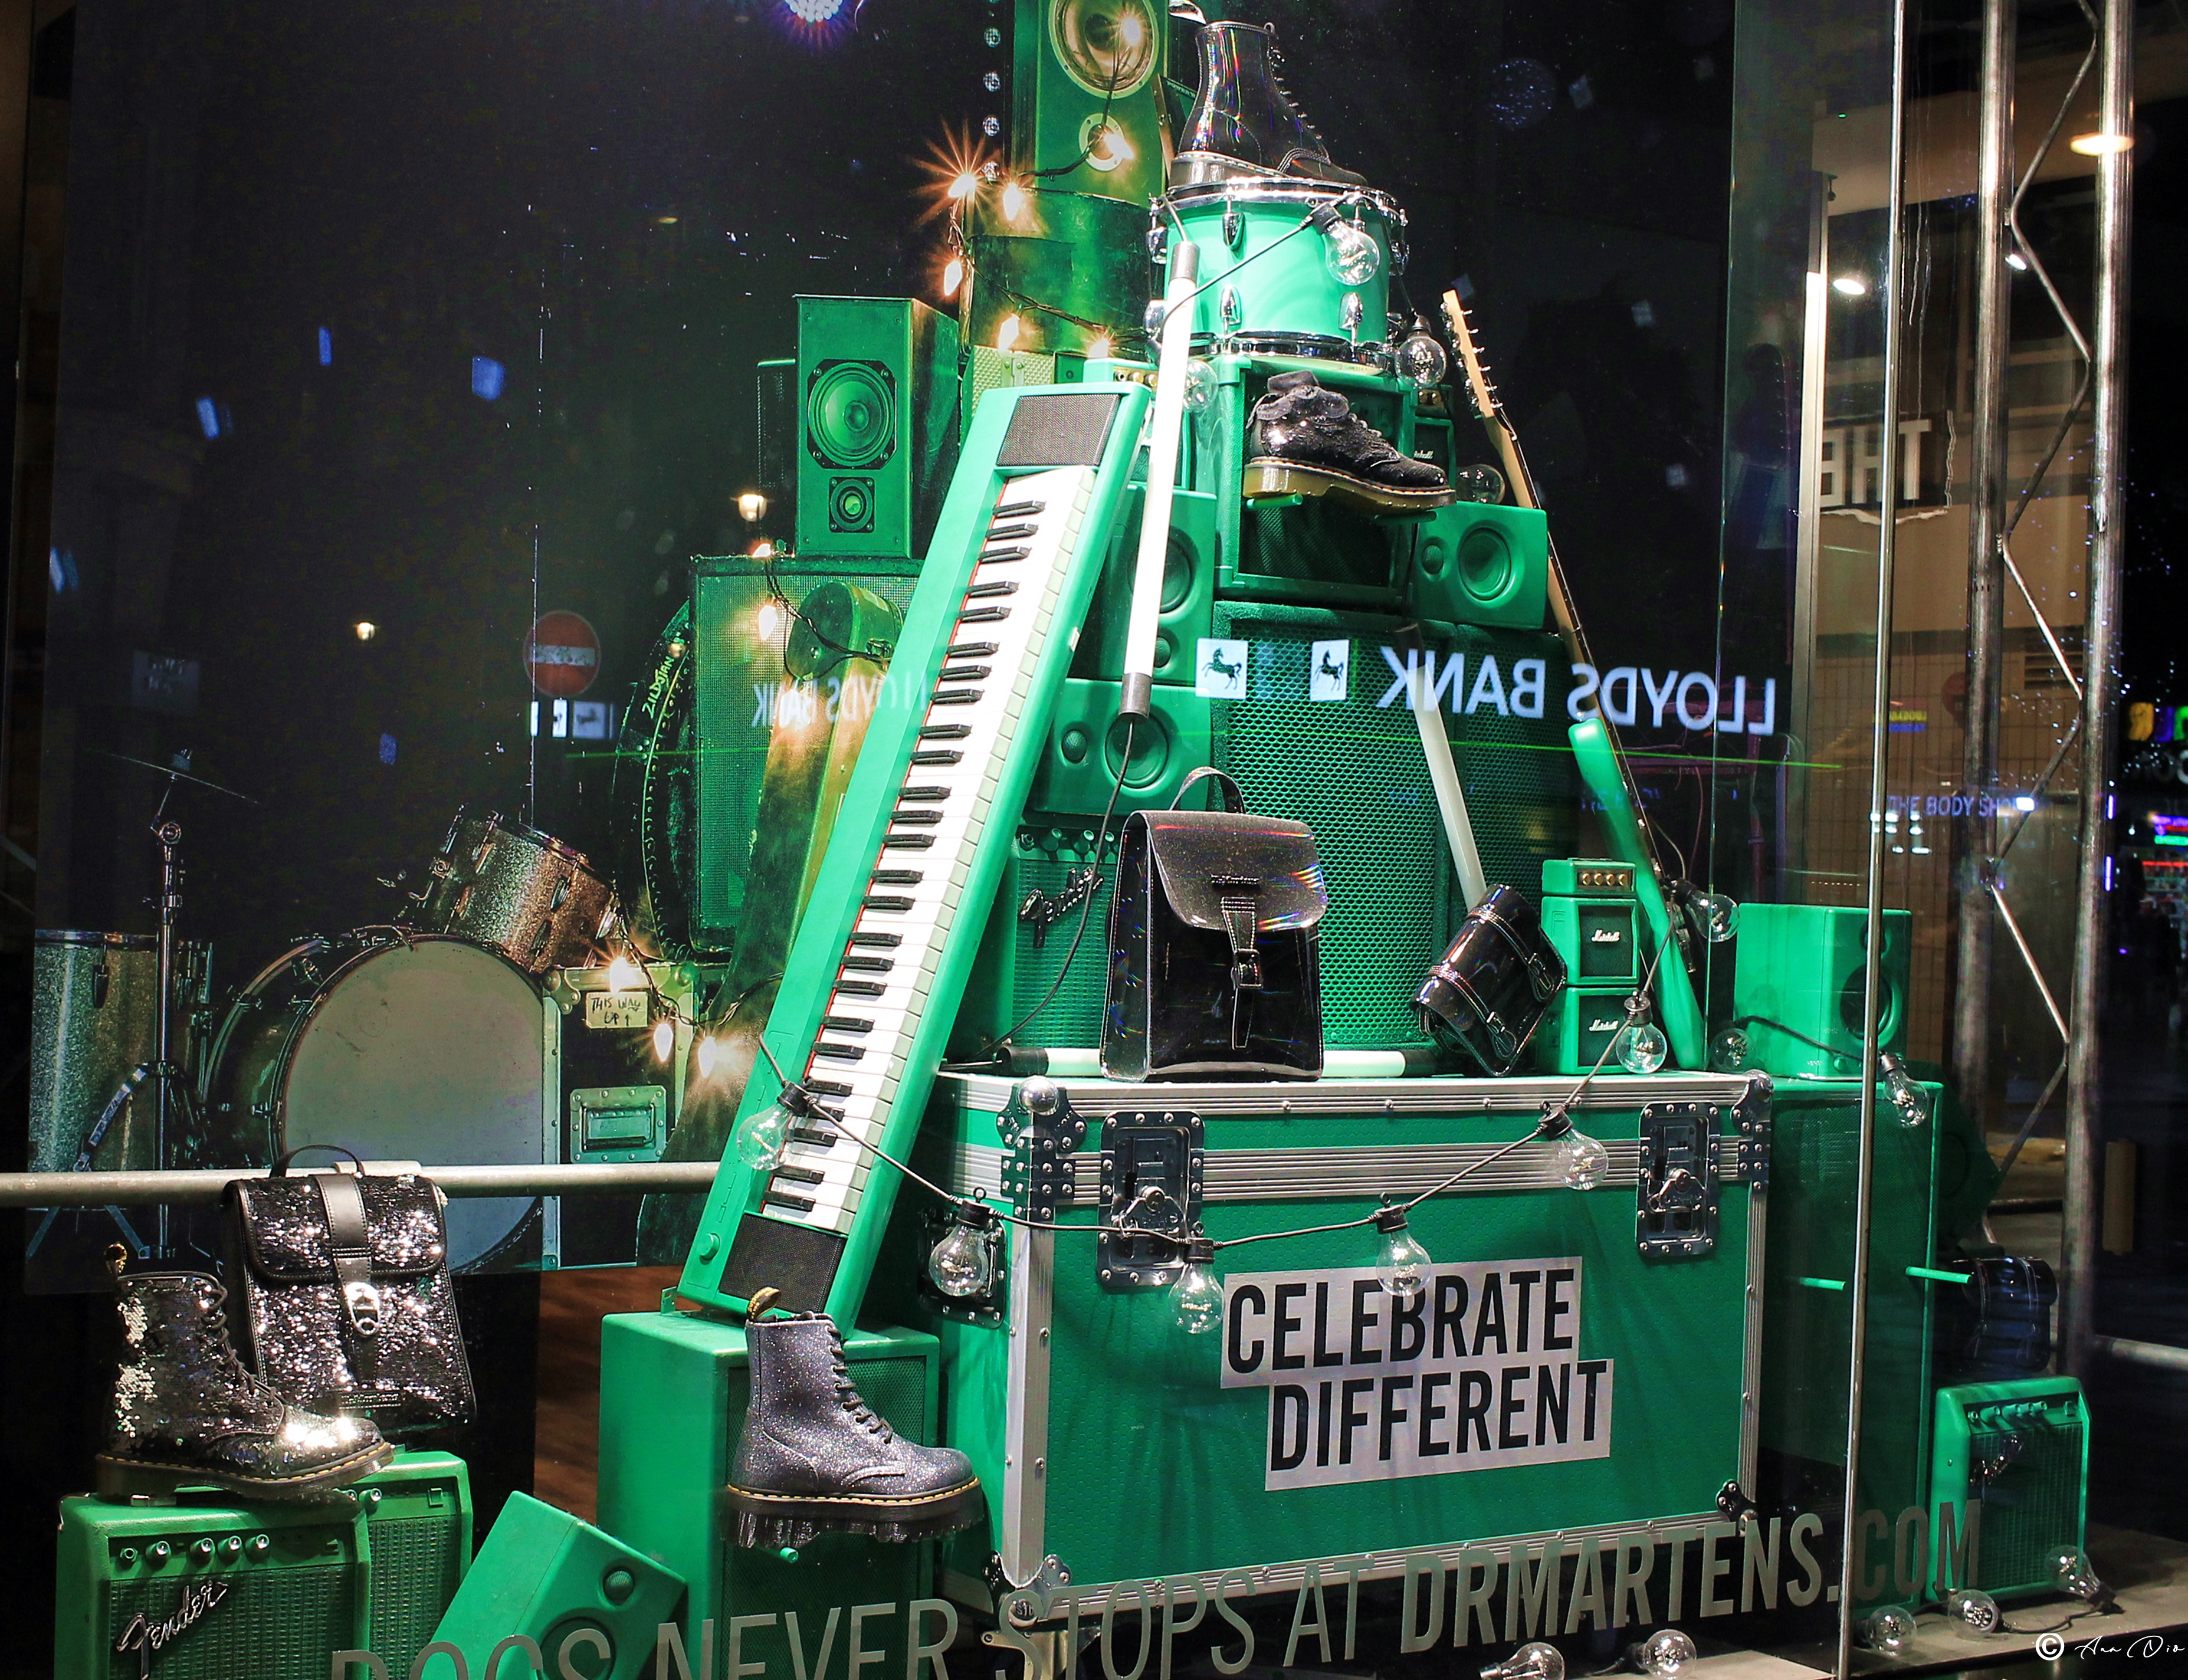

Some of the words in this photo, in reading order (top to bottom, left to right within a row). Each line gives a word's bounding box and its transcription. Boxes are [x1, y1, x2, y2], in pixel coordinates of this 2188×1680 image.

[1925, 796, 1975, 818] BODY
[591, 997, 614, 1014] THIS
[604, 1011, 619, 1025] UP
[1227, 1268, 1574, 1374] CELEBRATE
[1271, 1360, 1607, 1472] DIFFERENT
[116, 1580, 229, 1680] Fender
[995, 1568, 1257, 1680] STOPS
[1282, 1559, 1376, 1668] AT
